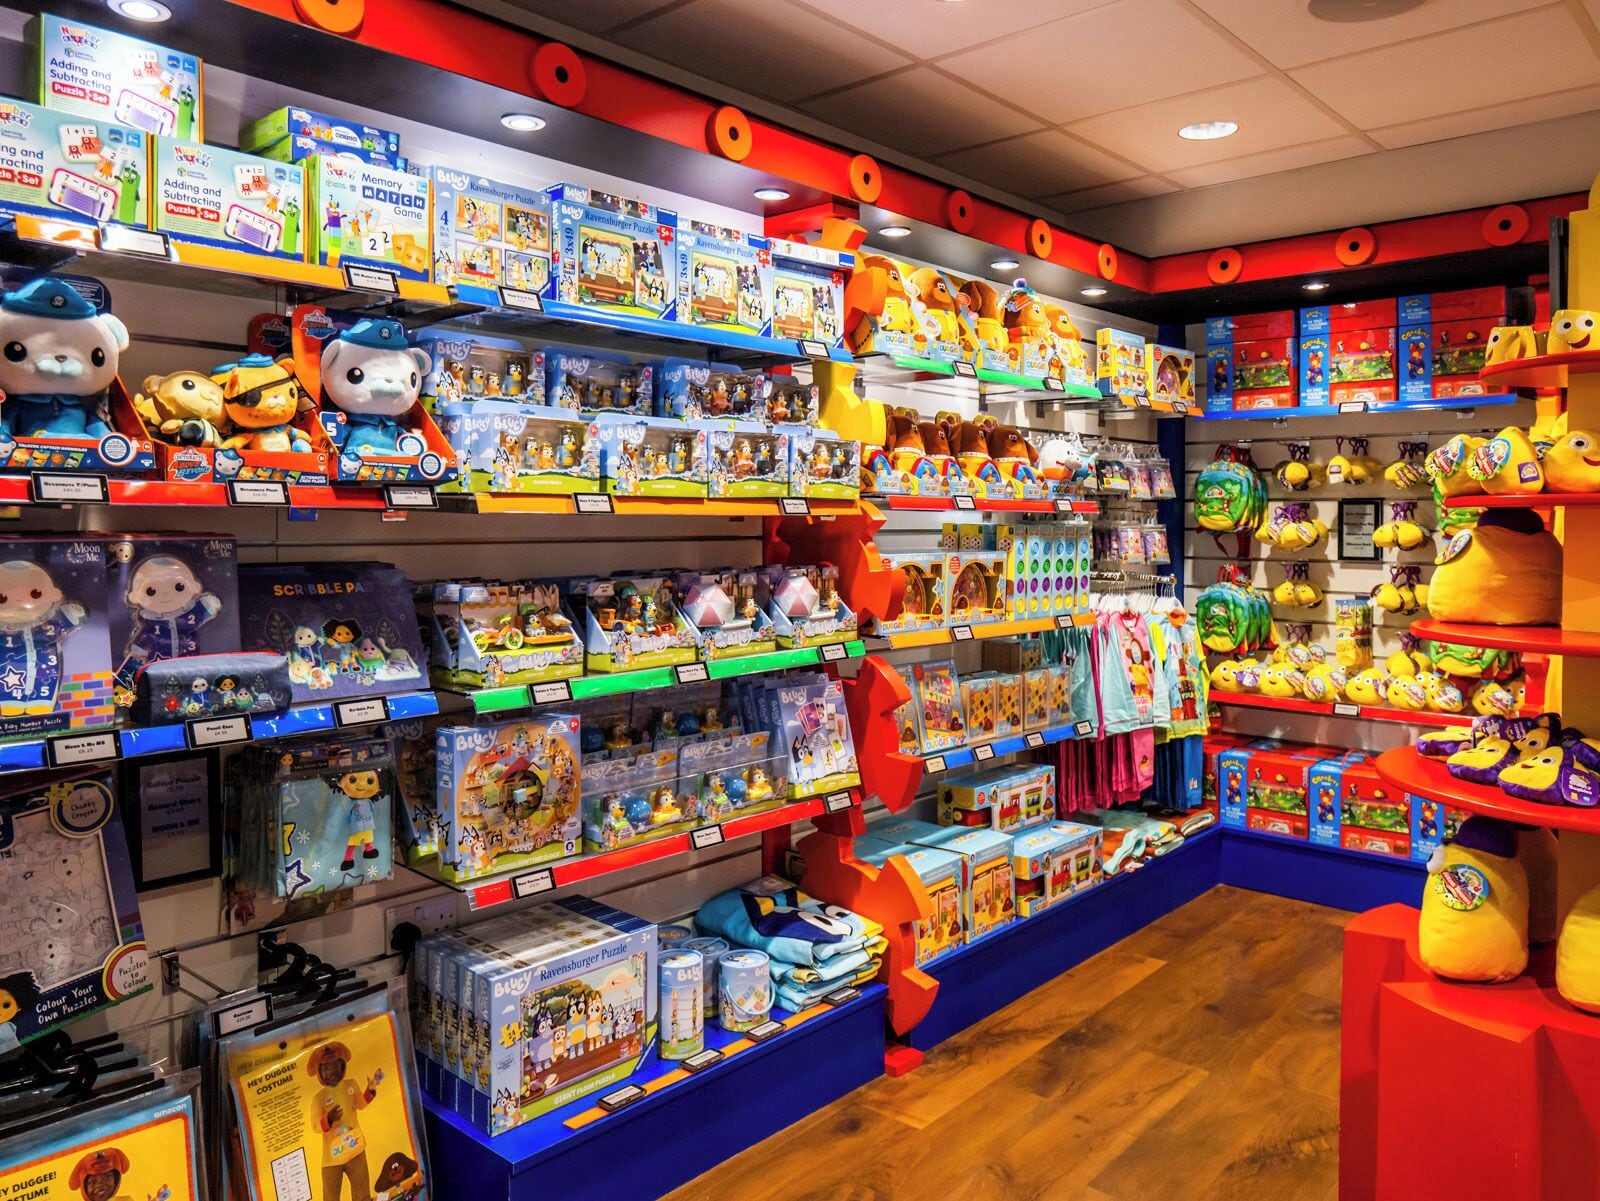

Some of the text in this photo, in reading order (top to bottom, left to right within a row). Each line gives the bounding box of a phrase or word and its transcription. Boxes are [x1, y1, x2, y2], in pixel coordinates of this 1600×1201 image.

[50, 58, 111, 80] Adding and
[50, 69, 111, 92] Subtracting
[54, 83, 108, 104] Puzzle Set
[20, 148, 44, 160] and
[22, 174, 39, 185] Set
[361, 173, 402, 191] Memory
[164, 178, 222, 197] Adding and
[470, 182, 535, 205] Ravensburger Puzzle
[164, 190, 221, 210] Subtracting
[363, 187, 424, 209] MATCH
[167, 203, 218, 221] Puzzle Set
[393, 207, 423, 220] Game
[440, 209, 449, 226] 4
[585, 210, 654, 236] Ravensburger Puzzle
[382, 232, 388, 244] 2
[660, 227, 671, 237] 5+
[370, 239, 377, 250] 2
[564, 227, 574, 255] 3x49
[696, 237, 754, 259] Ravensburger Puzzle
[758, 252, 769, 261] 5+
[680, 253, 688, 279] 3x49
[326, 421, 337, 436] 5
[74, 543, 100, 554] Moon
[210, 540, 232, 551] Moon
[85, 553, 99, 562] Me
[220, 549, 231, 558] Me
[273, 582, 343, 597] SCRIBBLE
[188, 615, 196, 624] 2
[46, 625, 55, 635] 2
[154, 625, 160, 634] 1
[7, 637, 13, 647] 1
[188, 641, 196, 650] 3
[48, 655, 57, 665] 3
[40, 686, 49, 696] 5
[20, 720, 41, 729] Number
[44, 717, 62, 726] Puzzle
[71, 801, 96, 811] Chunky
[72, 808, 98, 820] Crayons
[641, 932, 651, 944] 3+
[119, 962, 147, 976] Puzzles
[540, 943, 628, 982] Ravensburger Puzzle
[123, 976, 147, 990] Colour
[36, 985, 93, 1013] Colour Your
[38, 996, 97, 1024] Own Puzzles
[247, 1063, 297, 1088] HEY DUGGEE!
[256, 1074, 294, 1095] COSTUME
[553, 1091, 576, 1104] GIANT
[154, 1103, 187, 1119] amscan
[13, 1171, 57, 1192] DUGGEE!
